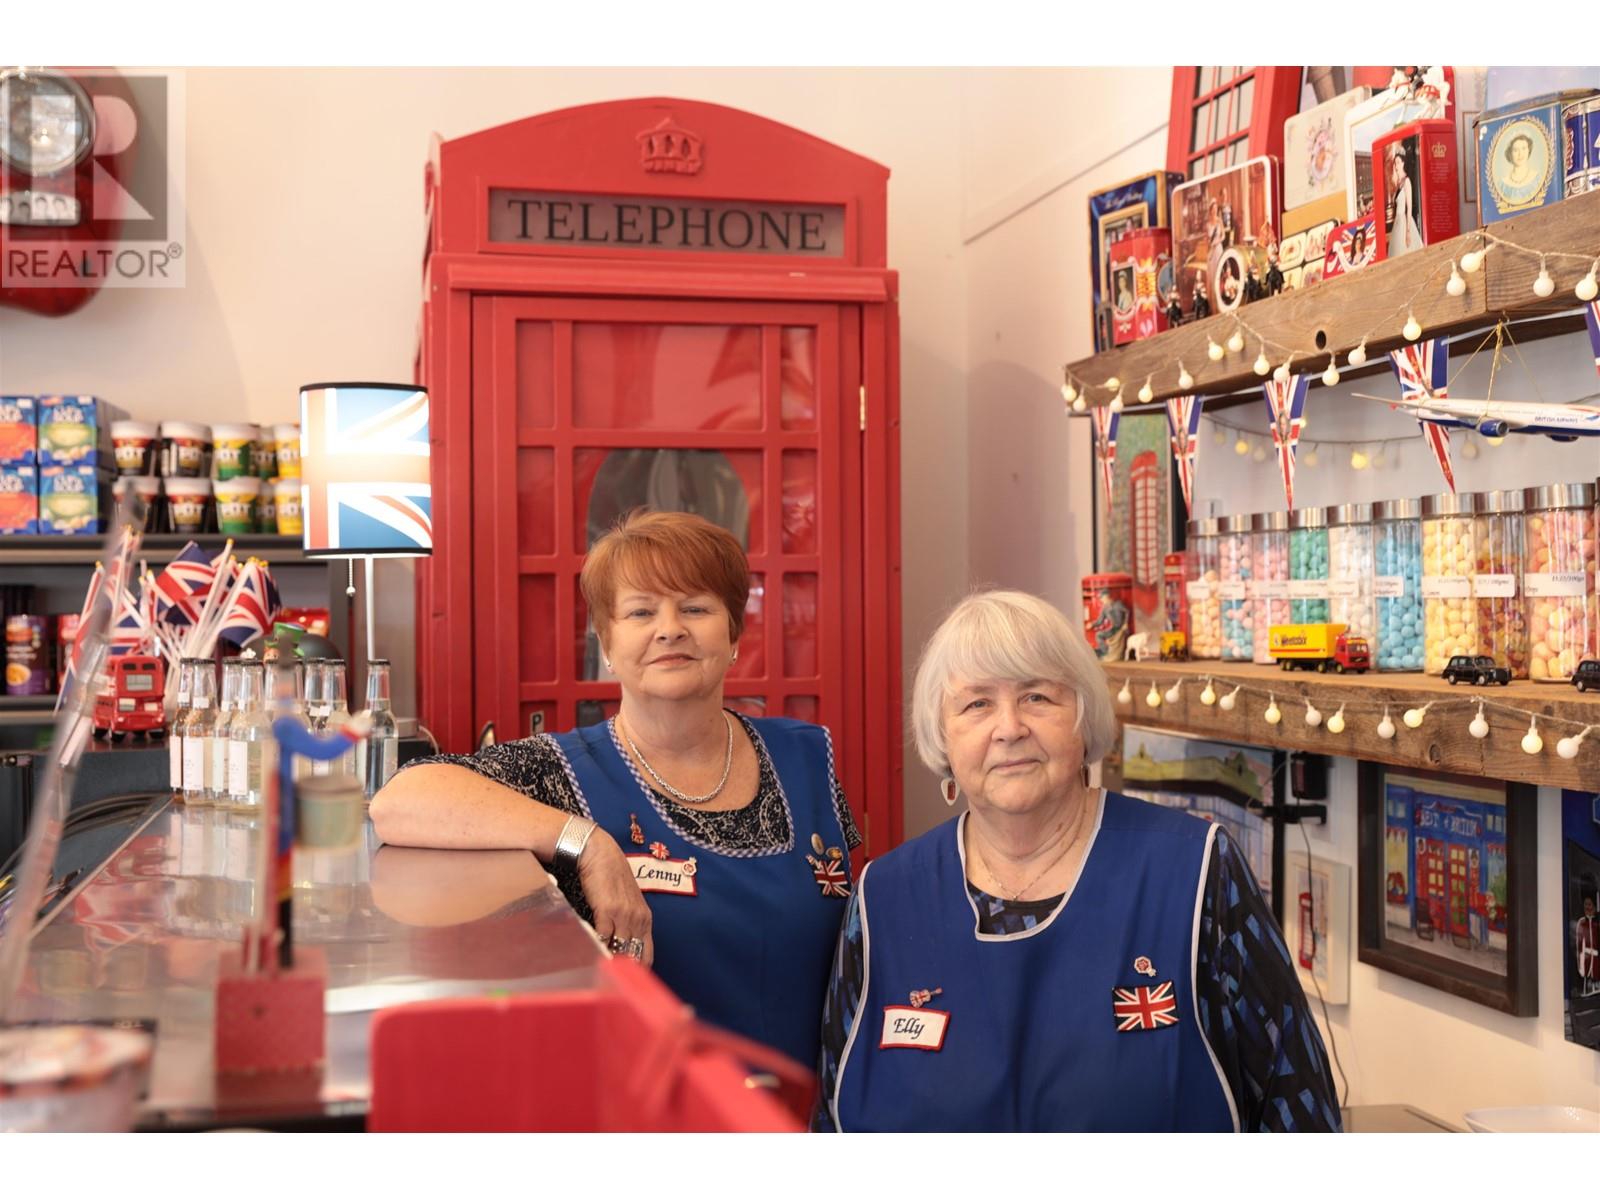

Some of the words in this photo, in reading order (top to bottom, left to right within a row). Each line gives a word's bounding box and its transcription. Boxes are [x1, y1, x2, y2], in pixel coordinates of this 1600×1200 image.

[507, 199, 827, 252] TELEPHONE
[636, 864, 682, 887] Lenny
[893, 1017, 925, 1040] Elly
